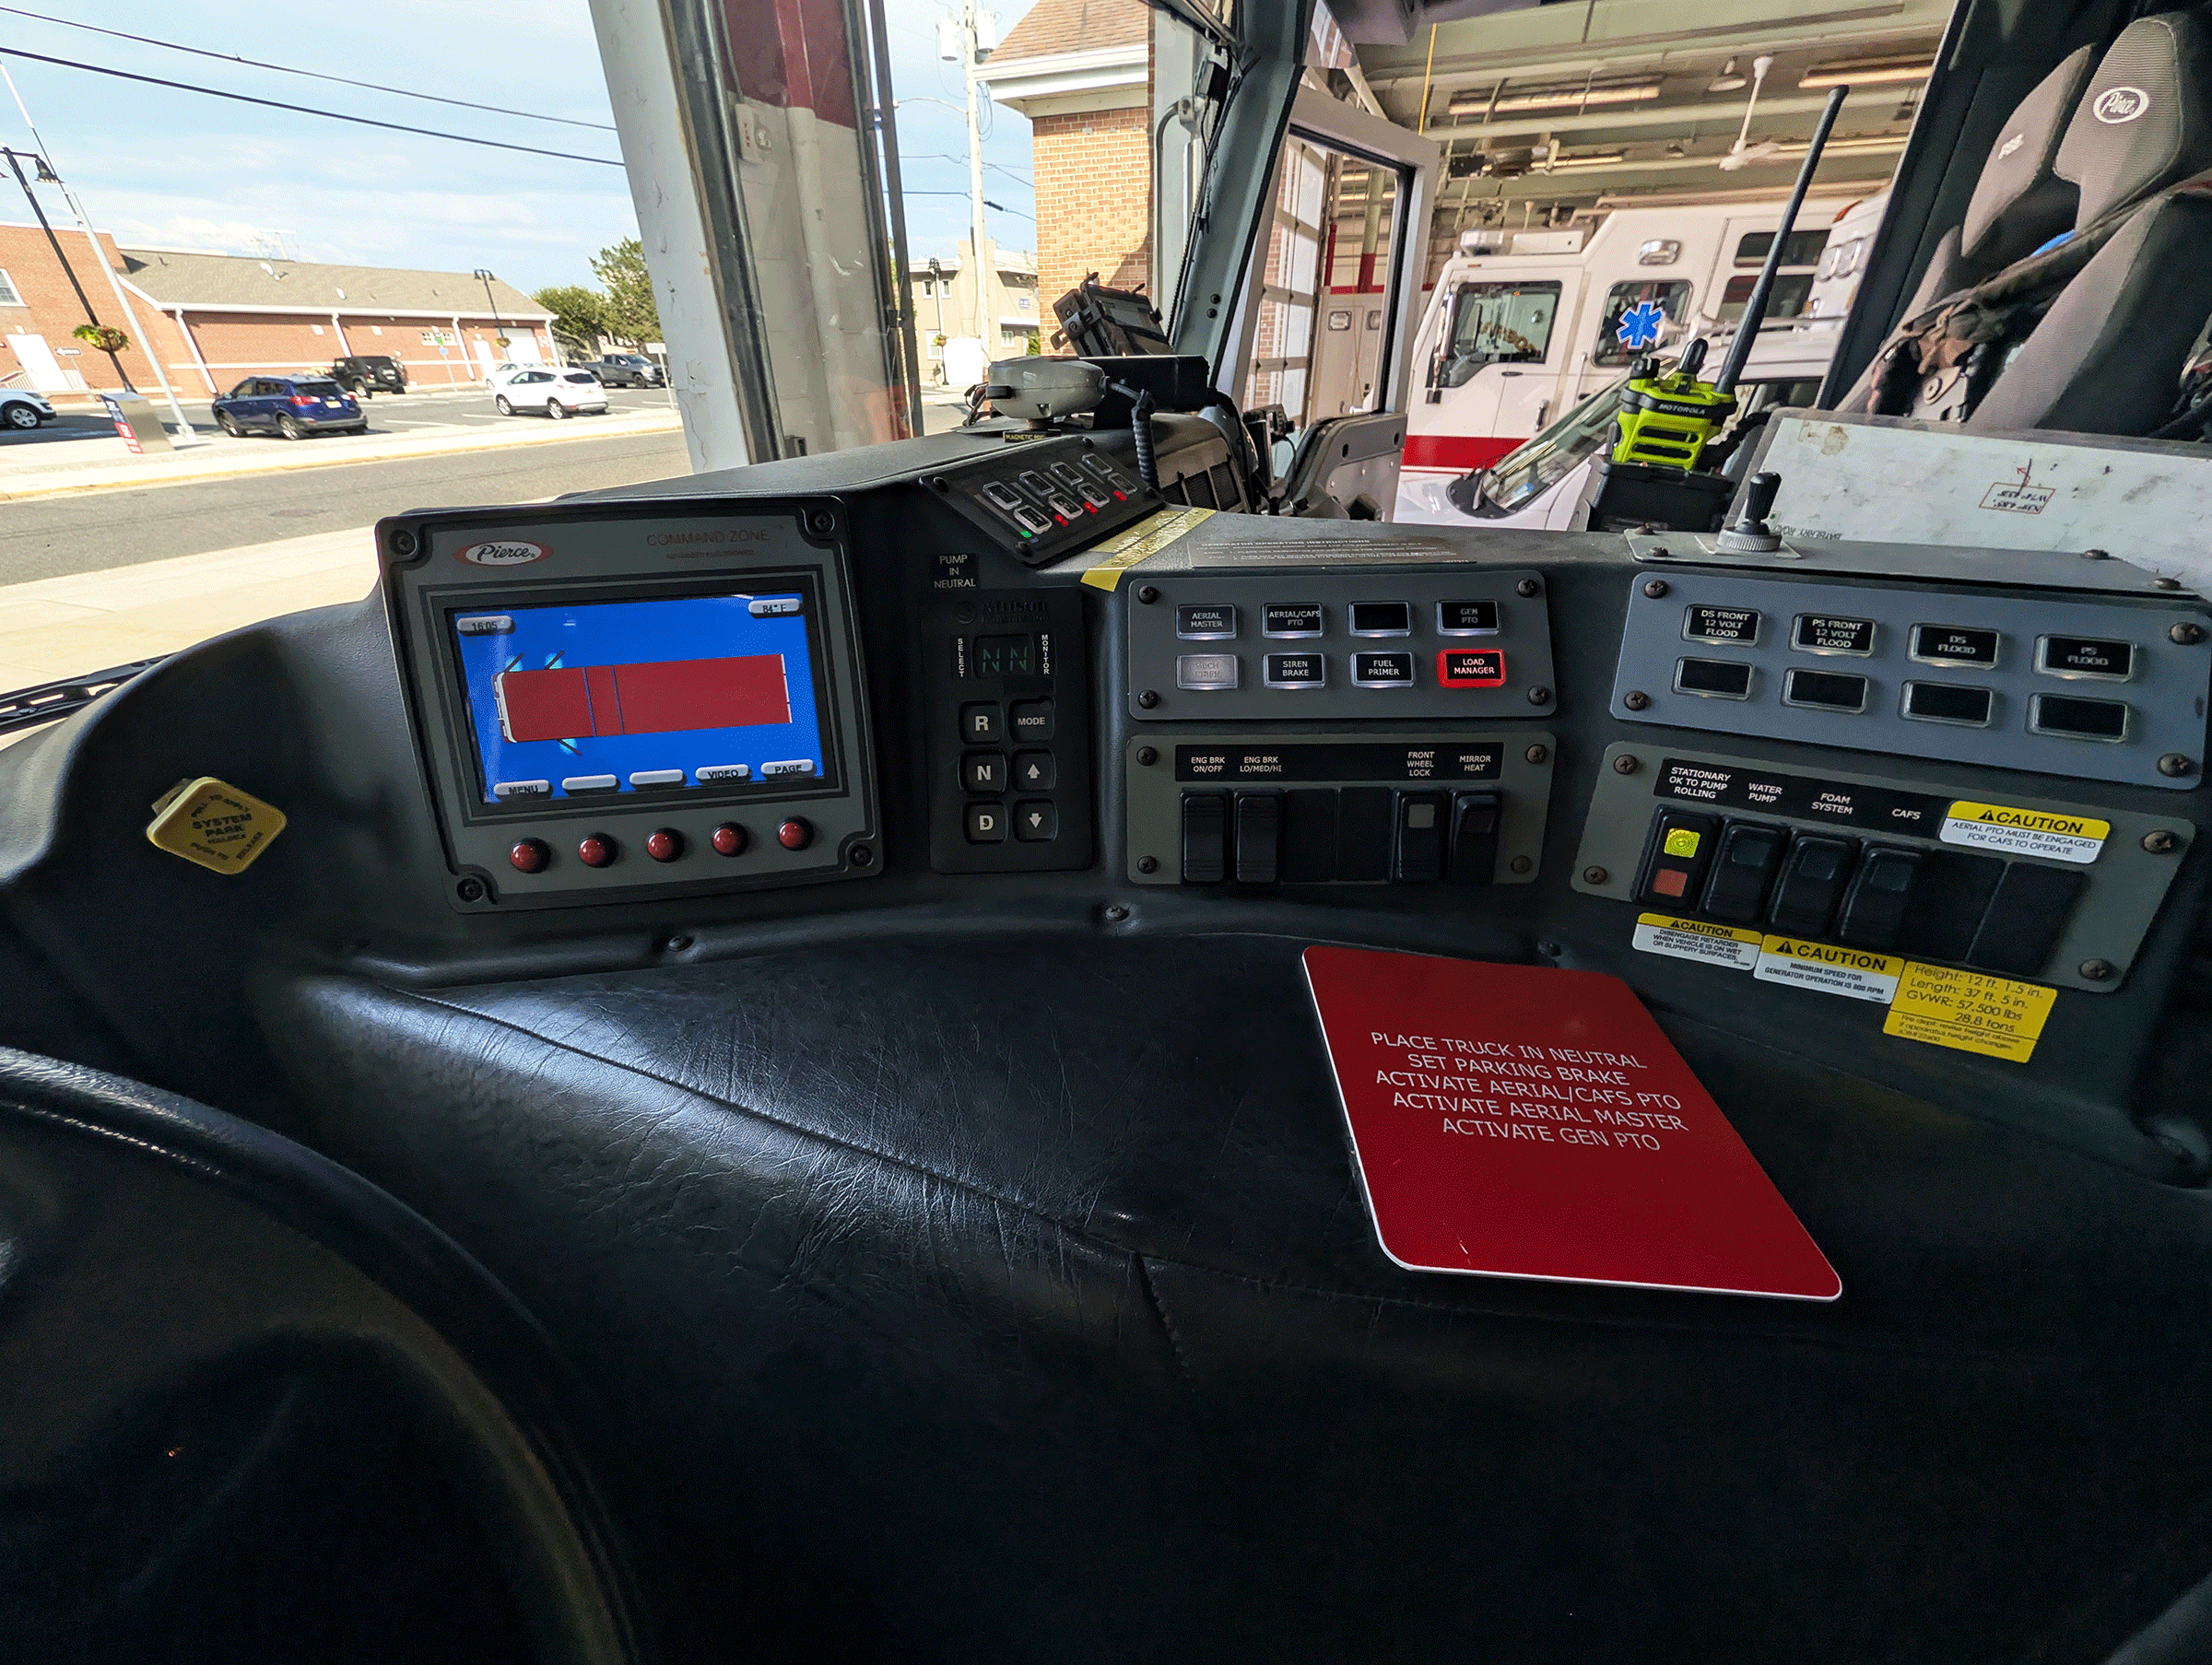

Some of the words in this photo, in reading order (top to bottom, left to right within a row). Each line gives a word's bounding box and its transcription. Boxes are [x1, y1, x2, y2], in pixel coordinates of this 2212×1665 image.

[1658, 404, 1706, 416] MOTOROLA
[647, 531, 724, 546] COMMAND
[730, 529, 770, 543] ZONE
[477, 544, 531, 562] Pierce
[939, 554, 968, 565] PUMP
[948, 567, 959, 577] IN
[934, 578, 977, 590] NEUTRAL
[1192, 612, 1221, 620] AERIAL
[1268, 610, 1321, 619] AERIAL/CAFS
[1460, 608, 1478, 616] GEN
[1700, 609, 1715, 618] DS
[1716, 611, 1751, 622] FRONT
[471, 620, 498, 631] 16:05
[1191, 620, 1223, 628] MASTER
[1288, 619, 1303, 627] PTO
[1461, 616, 1479, 625] PTO
[1704, 619, 1715, 627] 12
[1719, 620, 1744, 630] VOLT
[1812, 618, 1826, 628] PS
[1828, 620, 1864, 632] FRONT
[1705, 628, 1739, 639] FLOOD
[1815, 628, 1827, 638] 12
[1830, 630, 1857, 640] VOLT
[1817, 639, 1852, 650] FLOOD
[1949, 635, 1967, 646] DS
[1041, 634, 1051, 675] MONITOR
[1937, 644, 1976, 656] FLOOD
[2080, 646, 2099, 657] PS
[1282, 660, 1308, 668] SIREN
[1373, 659, 1394, 667] FUEL
[1462, 658, 1485, 666] LOAD
[2066, 655, 2109, 667] FLOOD
[1282, 669, 1310, 677] BRAKE
[1368, 668, 1400, 676] PRIMER
[1453, 666, 1495, 675] MANAGER
[975, 715, 989, 732] R
[1018, 716, 1046, 726] MODE
[1191, 756, 1207, 764] ENG
[1209, 756, 1226, 764] BRK
[1243, 756, 1260, 764] ENG
[1262, 756, 1278, 764] BRK
[1407, 751, 1435, 760] FRONT
[1459, 755, 1491, 764] MIRROR
[774, 764, 803, 775] PAGE
[1193, 765, 1223, 774] ON/OFF
[1240, 765, 1282, 774] LO/MED/HI
[1406, 760, 1434, 768] WHEEL
[1464, 764, 1486, 772] HEAT
[708, 769, 739, 780] VIDEO
[977, 765, 992, 781] N
[1409, 768, 1430, 778] LOCK
[1670, 767, 1731, 782] STATIONARY
[508, 784, 538, 795] MENU
[1669, 776, 1682, 786] OK
[1685, 779, 1699, 787] TO
[1700, 780, 1728, 792] PUMP
[1747, 782, 1783, 796] WATER
[1674, 786, 1717, 800] ROLLING
[1748, 792, 1777, 804] PUMP
[1820, 792, 1852, 805] FOAM
[1811, 802, 1853, 816] SYSTEM
[1891, 808, 1922, 821] CAFS
[979, 815, 994, 831] D
[1996, 812, 2084, 834] CAUTION
[1951, 821, 1983, 831] AERIAL
[2006, 830, 2030, 838] MUST
[2046, 836, 2097, 849] ENGAGED
[1967, 833, 1987, 842] FOR
[1988, 836, 2012, 846] CAFS
[2015, 839, 2028, 848] TO
[2030, 842, 2073, 854] OPERATE
[1680, 921, 1735, 937] CAUTION
[1659, 929, 1700, 941] DISENGAGE
[1700, 937, 1739, 947] RETARDER
[1653, 934, 1674, 943] WHEN
[1675, 937, 1704, 947] VEHICLE
[1725, 946, 1742, 955] WET
[1665, 943, 1697, 953] SLIPPERY
[1796, 944, 1888, 971] CAUTION
[1790, 962, 1823, 972] MINIMUM
[1823, 968, 1847, 978] SPEED
[1847, 974, 1863, 982] FOR
[1764, 967, 1804, 979] GENERATOR
[1805, 974, 1843, 986] OPERATION
[1866, 986, 1885, 995] RPM
[1914, 965, 1962, 980] Height:
[1967, 975, 1983, 984] 12
[1986, 979, 1998, 988] ft.
[2005, 982, 2024, 993] 1.5
[1910, 978, 1960, 993] Length:
[1963, 987, 1982, 997] 37
[1983, 991, 1996, 1002] ft.
[2000, 995, 2010, 1004] 5
[2012, 996, 2029, 1008] in.
[1906, 990, 1954, 1006] GVWR:
[2003, 1006, 2024, 1020] lbs
[1954, 1013, 1983, 1026] 28.8
[1985, 1017, 2016, 1032] tons
[1371, 1031, 1438, 1051] PLACE
[1441, 1038, 1512, 1058] TRUCK
[1520, 1045, 1545, 1061] IN
[1549, 1048, 1648, 1070] NEUTRAL
[1408, 1053, 1448, 1070] SET
[1456, 1058, 1551, 1080] PARKING
[1557, 1067, 1631, 1086] BRAKE
[1376, 1070, 1483, 1094] ACTIVATE
[1489, 1080, 1633, 1107] AERIAL/CAFS
[1639, 1092, 1682, 1111] PTO
[1393, 1092, 1501, 1116] ACTIVATE
[1509, 1102, 1592, 1124] AERIAL
[1596, 1110, 1690, 1131] MASTER
[1442, 1118, 1555, 1143] ACTIVATE
[1559, 1128, 1611, 1147] GEN
[1616, 1133, 1662, 1151] PTO
